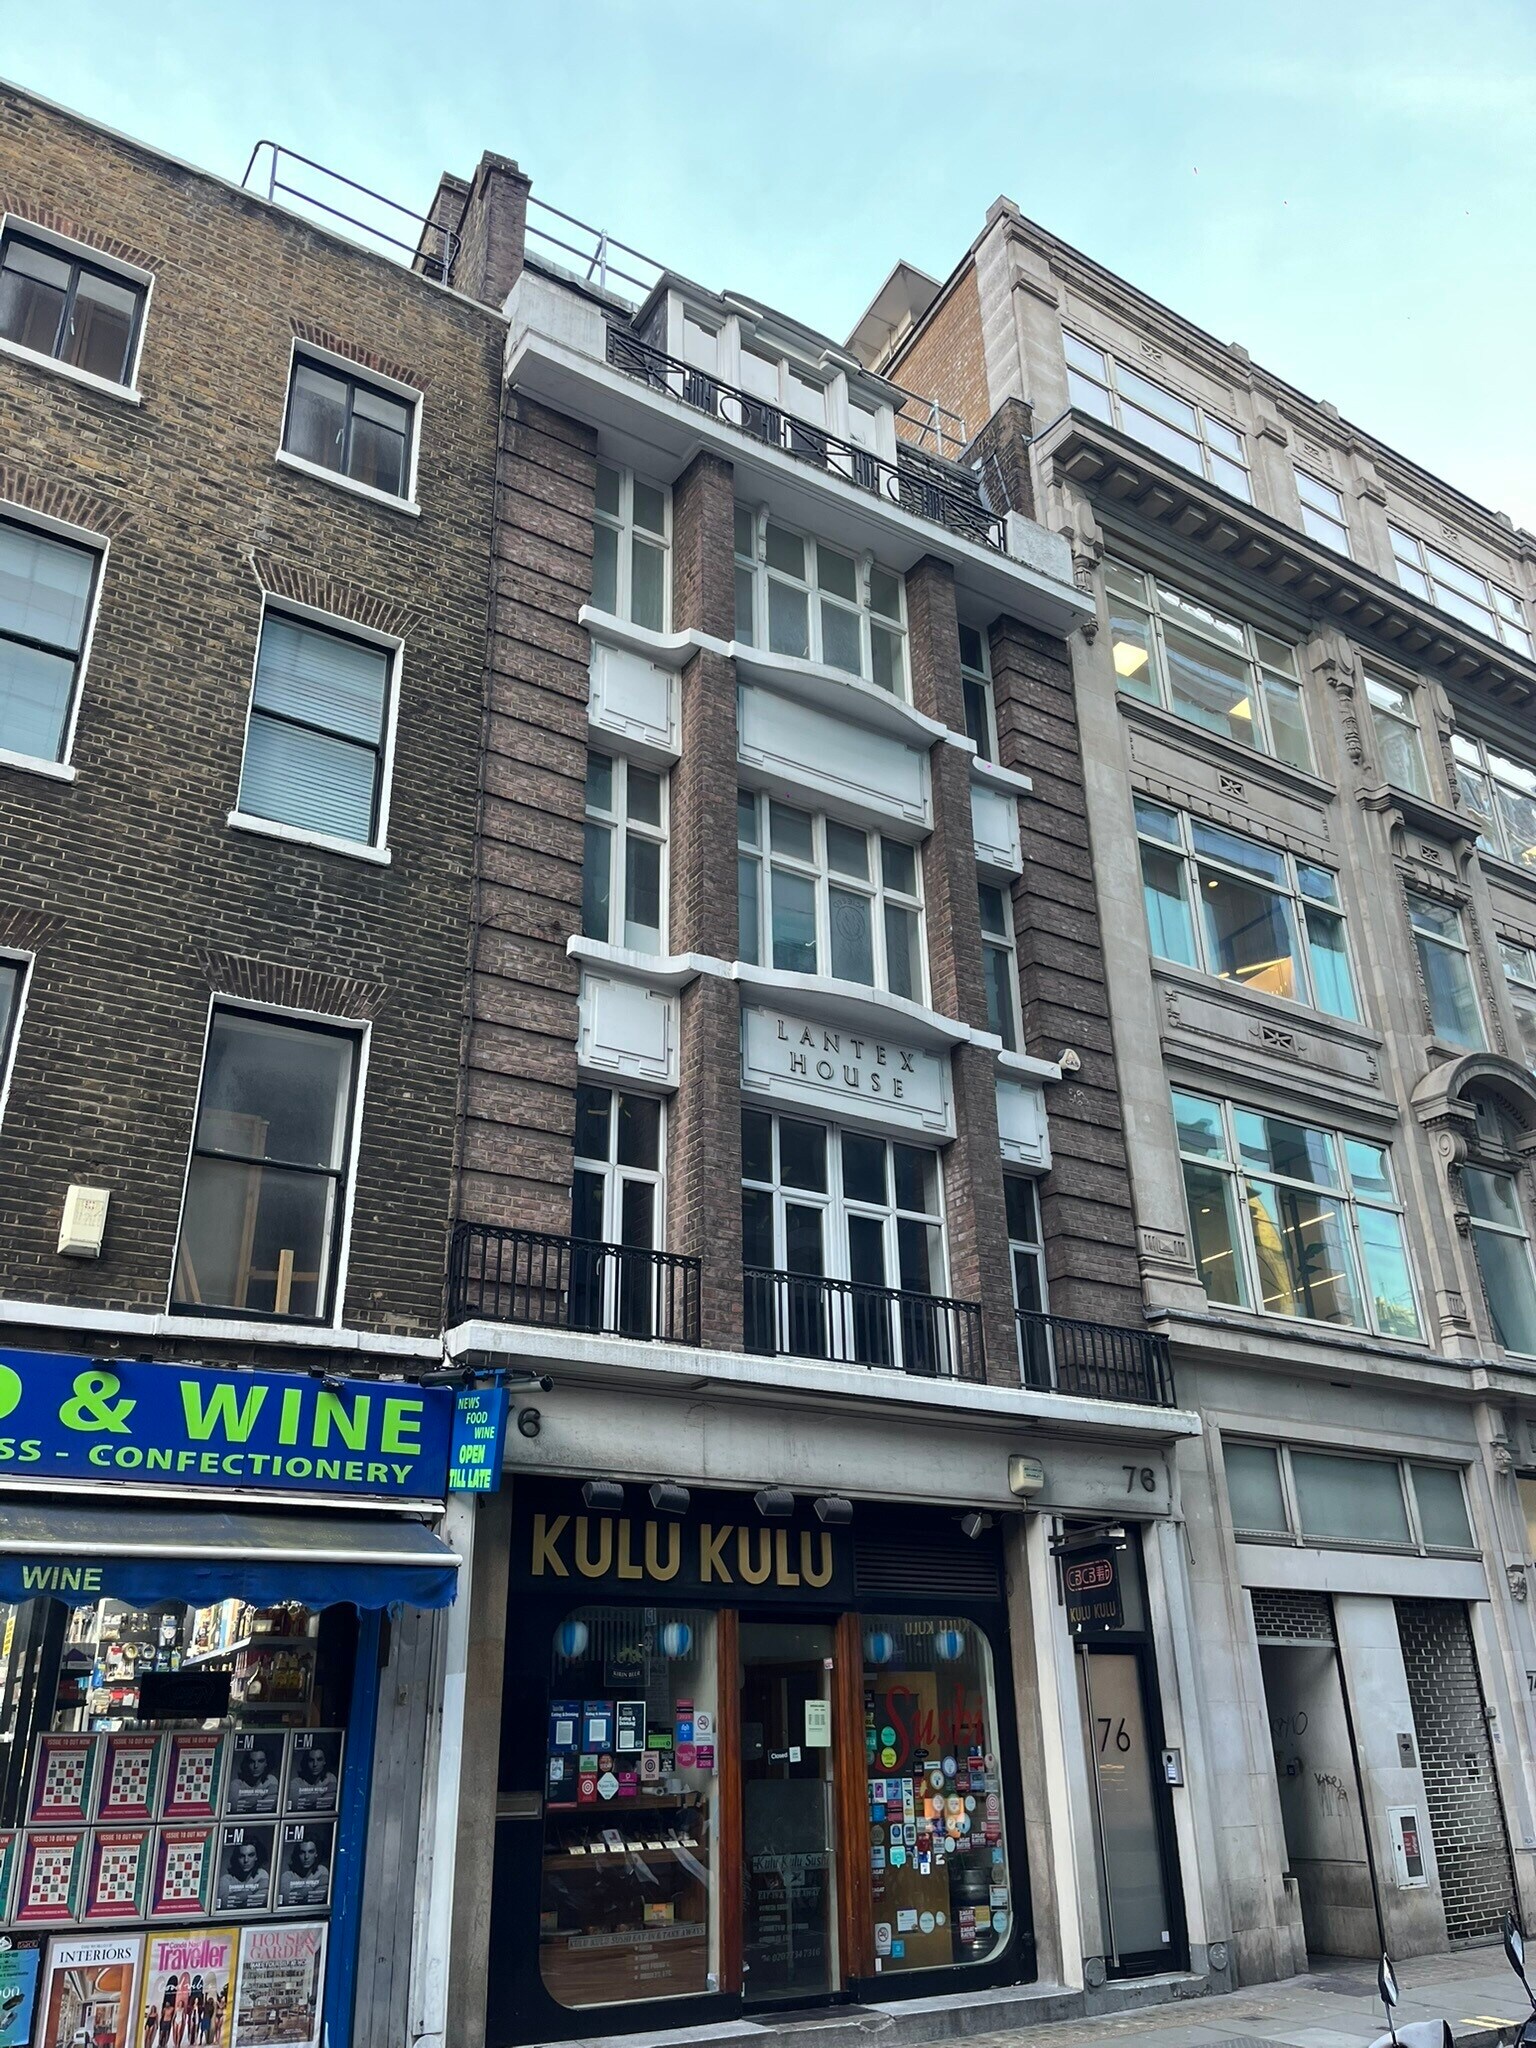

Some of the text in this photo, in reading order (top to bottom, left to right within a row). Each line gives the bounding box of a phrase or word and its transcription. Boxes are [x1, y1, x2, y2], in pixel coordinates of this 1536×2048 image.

[777, 1019, 915, 1073] LANTEX
[790, 1051, 904, 1098] HOUSE
[59, 1370, 137, 1434] &
[180, 1380, 424, 1456] WINE
[458, 1397, 480, 1410] NEWS
[466, 1411, 488, 1425] FOOD
[474, 1426, 496, 1440] WINE
[89, 1444, 414, 1485] CONFECTIONERY
[459, 1444, 486, 1465] OPEN
[449, 1468, 492, 1488] TILL LATE
[1122, 1465, 1156, 1493] 76
[531, 1513, 833, 1588] KULU KULU
[22, 1565, 103, 1592] WINE
[1069, 1602, 1116, 1623] KULU KULU
[873, 1681, 986, 1773] Sushi
[1097, 1717, 1131, 1752] 76
[100, 1833, 114, 1841] ISSUE
[132, 1832, 143, 1840] NOW
[223, 1828, 244, 1844] I-M
[284, 1825, 305, 1840] I-M
[251, 1932, 303, 1947] HOUSE
[60, 1947, 132, 1963] INTERIORS
[158, 1940, 227, 1972] Traveller
[250, 1944, 315, 1960] GARDEN
